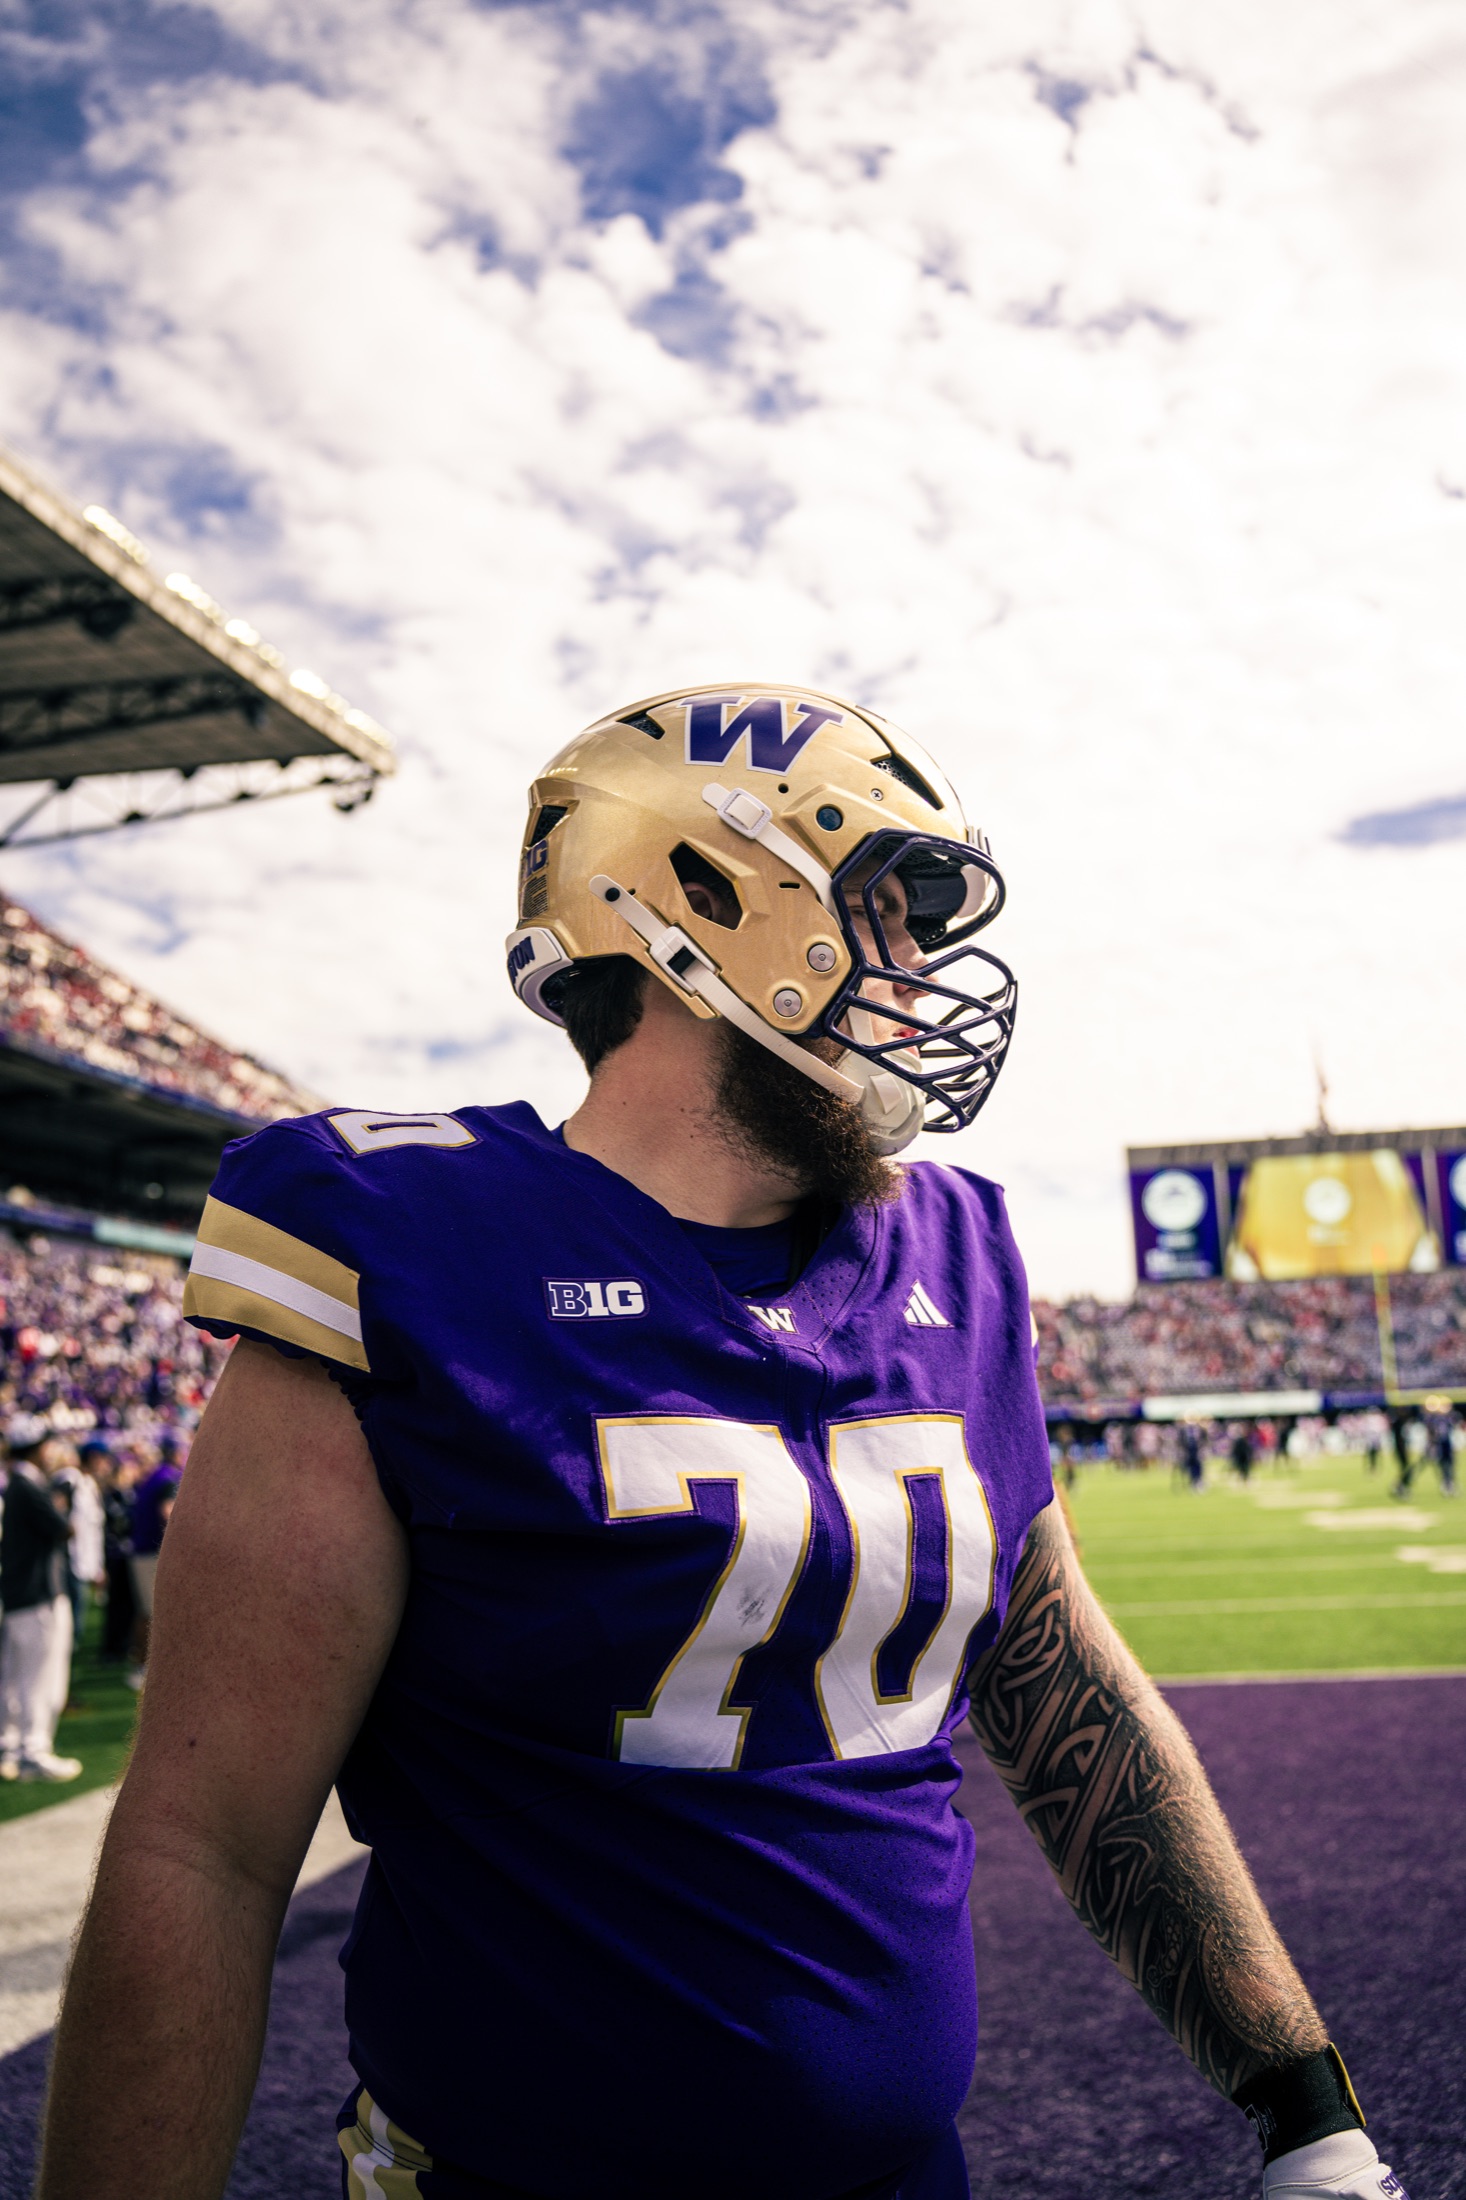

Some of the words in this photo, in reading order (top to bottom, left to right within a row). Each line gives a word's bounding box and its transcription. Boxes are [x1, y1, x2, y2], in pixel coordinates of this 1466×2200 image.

[677, 695, 847, 777] W
[746, 1304, 799, 1333] W
[595, 1414, 998, 1773] 70
